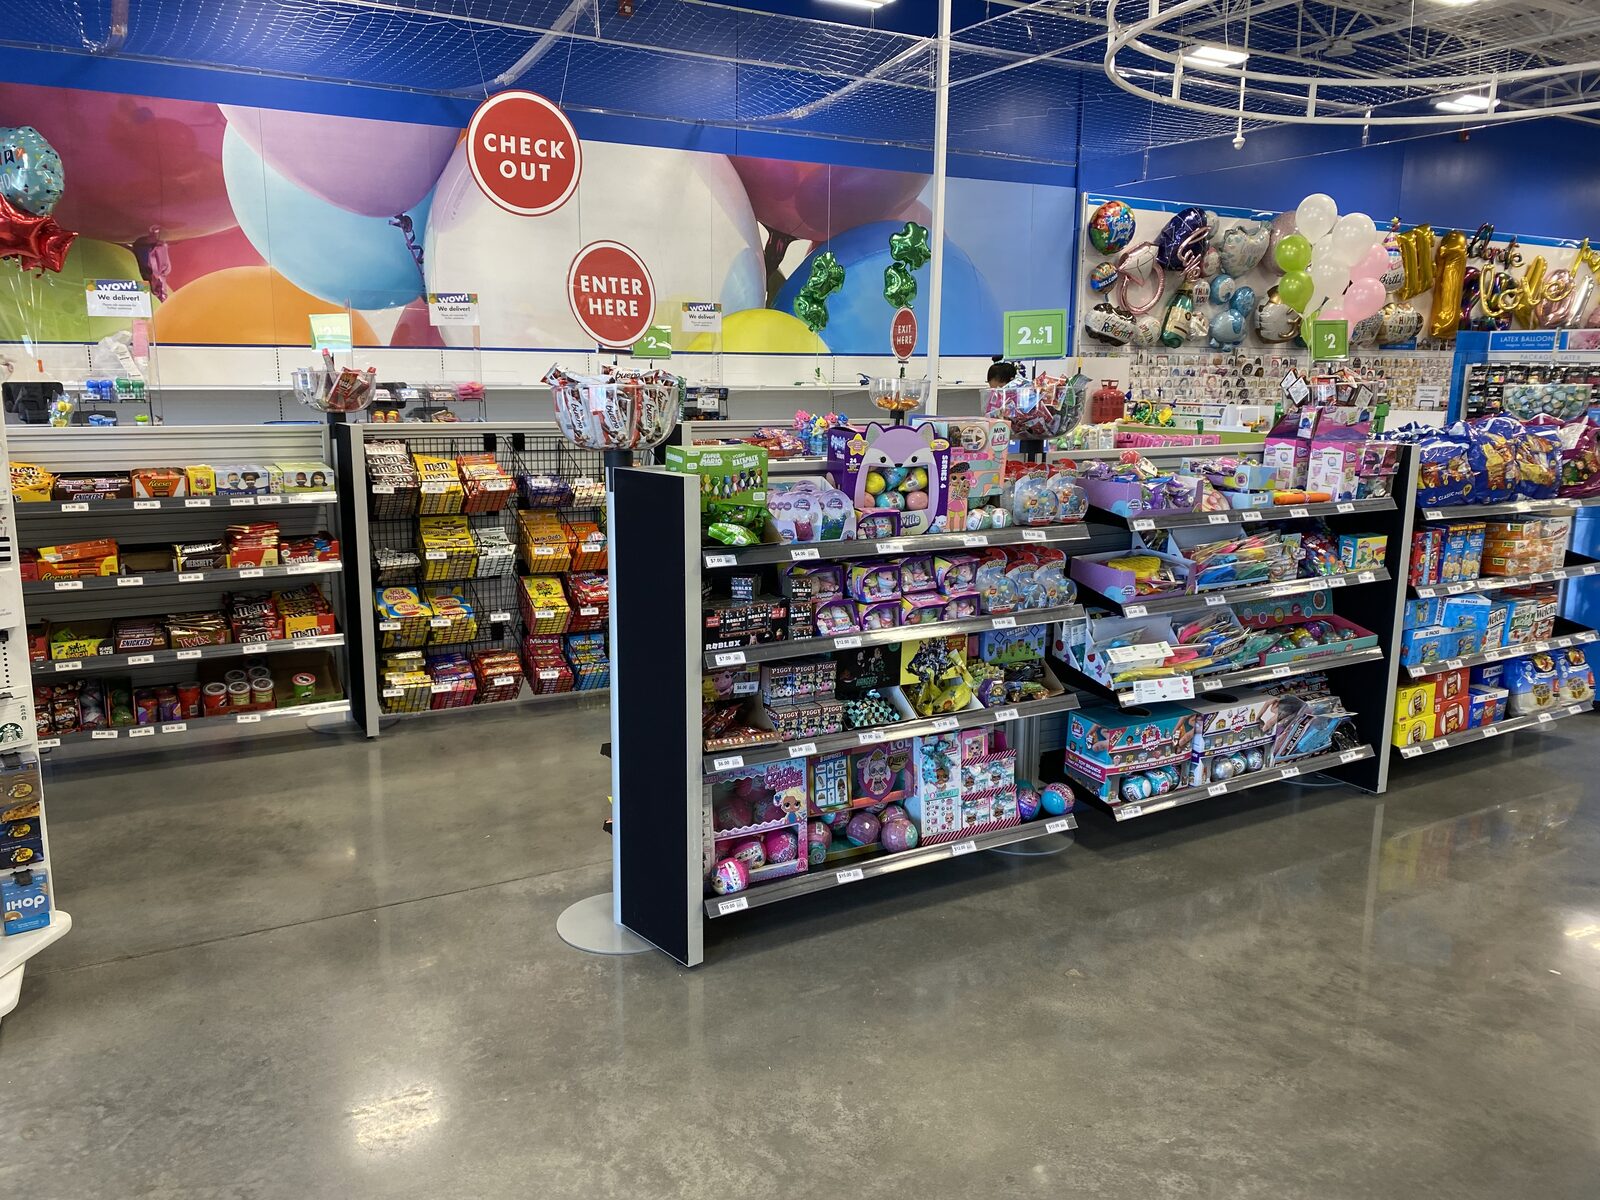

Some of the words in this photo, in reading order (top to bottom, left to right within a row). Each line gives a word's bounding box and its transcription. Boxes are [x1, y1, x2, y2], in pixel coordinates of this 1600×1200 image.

[483, 132, 565, 159] CHECK
[499, 160, 551, 182] OUT
[580, 275, 644, 296] ENTER
[588, 298, 639, 317] HERE
[898, 325, 912, 334] EXIT
[897, 335, 912, 345] HERE
[1018, 326, 1032, 345] 2
[1038, 326, 1053, 344] $1
[1324, 333, 1336, 349] $2
[644, 336, 656, 349] $2
[615, 370, 640, 380] bueno
[571, 403, 583, 429] bueno
[606, 405, 620, 429] bueno
[1438, 492, 1454, 501] CLASSIC
[900, 514, 921, 528] ville
[285, 555, 319, 566] Skittles
[748, 612, 766, 620] ROBLOX
[119, 637, 153, 648] SNICKERS
[176, 634, 211, 648] Twix
[706, 640, 741, 650] ROBLOX
[795, 665, 814, 673] PIGGY
[801, 709, 821, 717] PIGGY
[823, 705, 842, 713] PIGGY
[778, 711, 798, 719] PIGGY
[1085, 763, 1101, 774] BRANDS
[6, 894, 45, 911] IHOP
